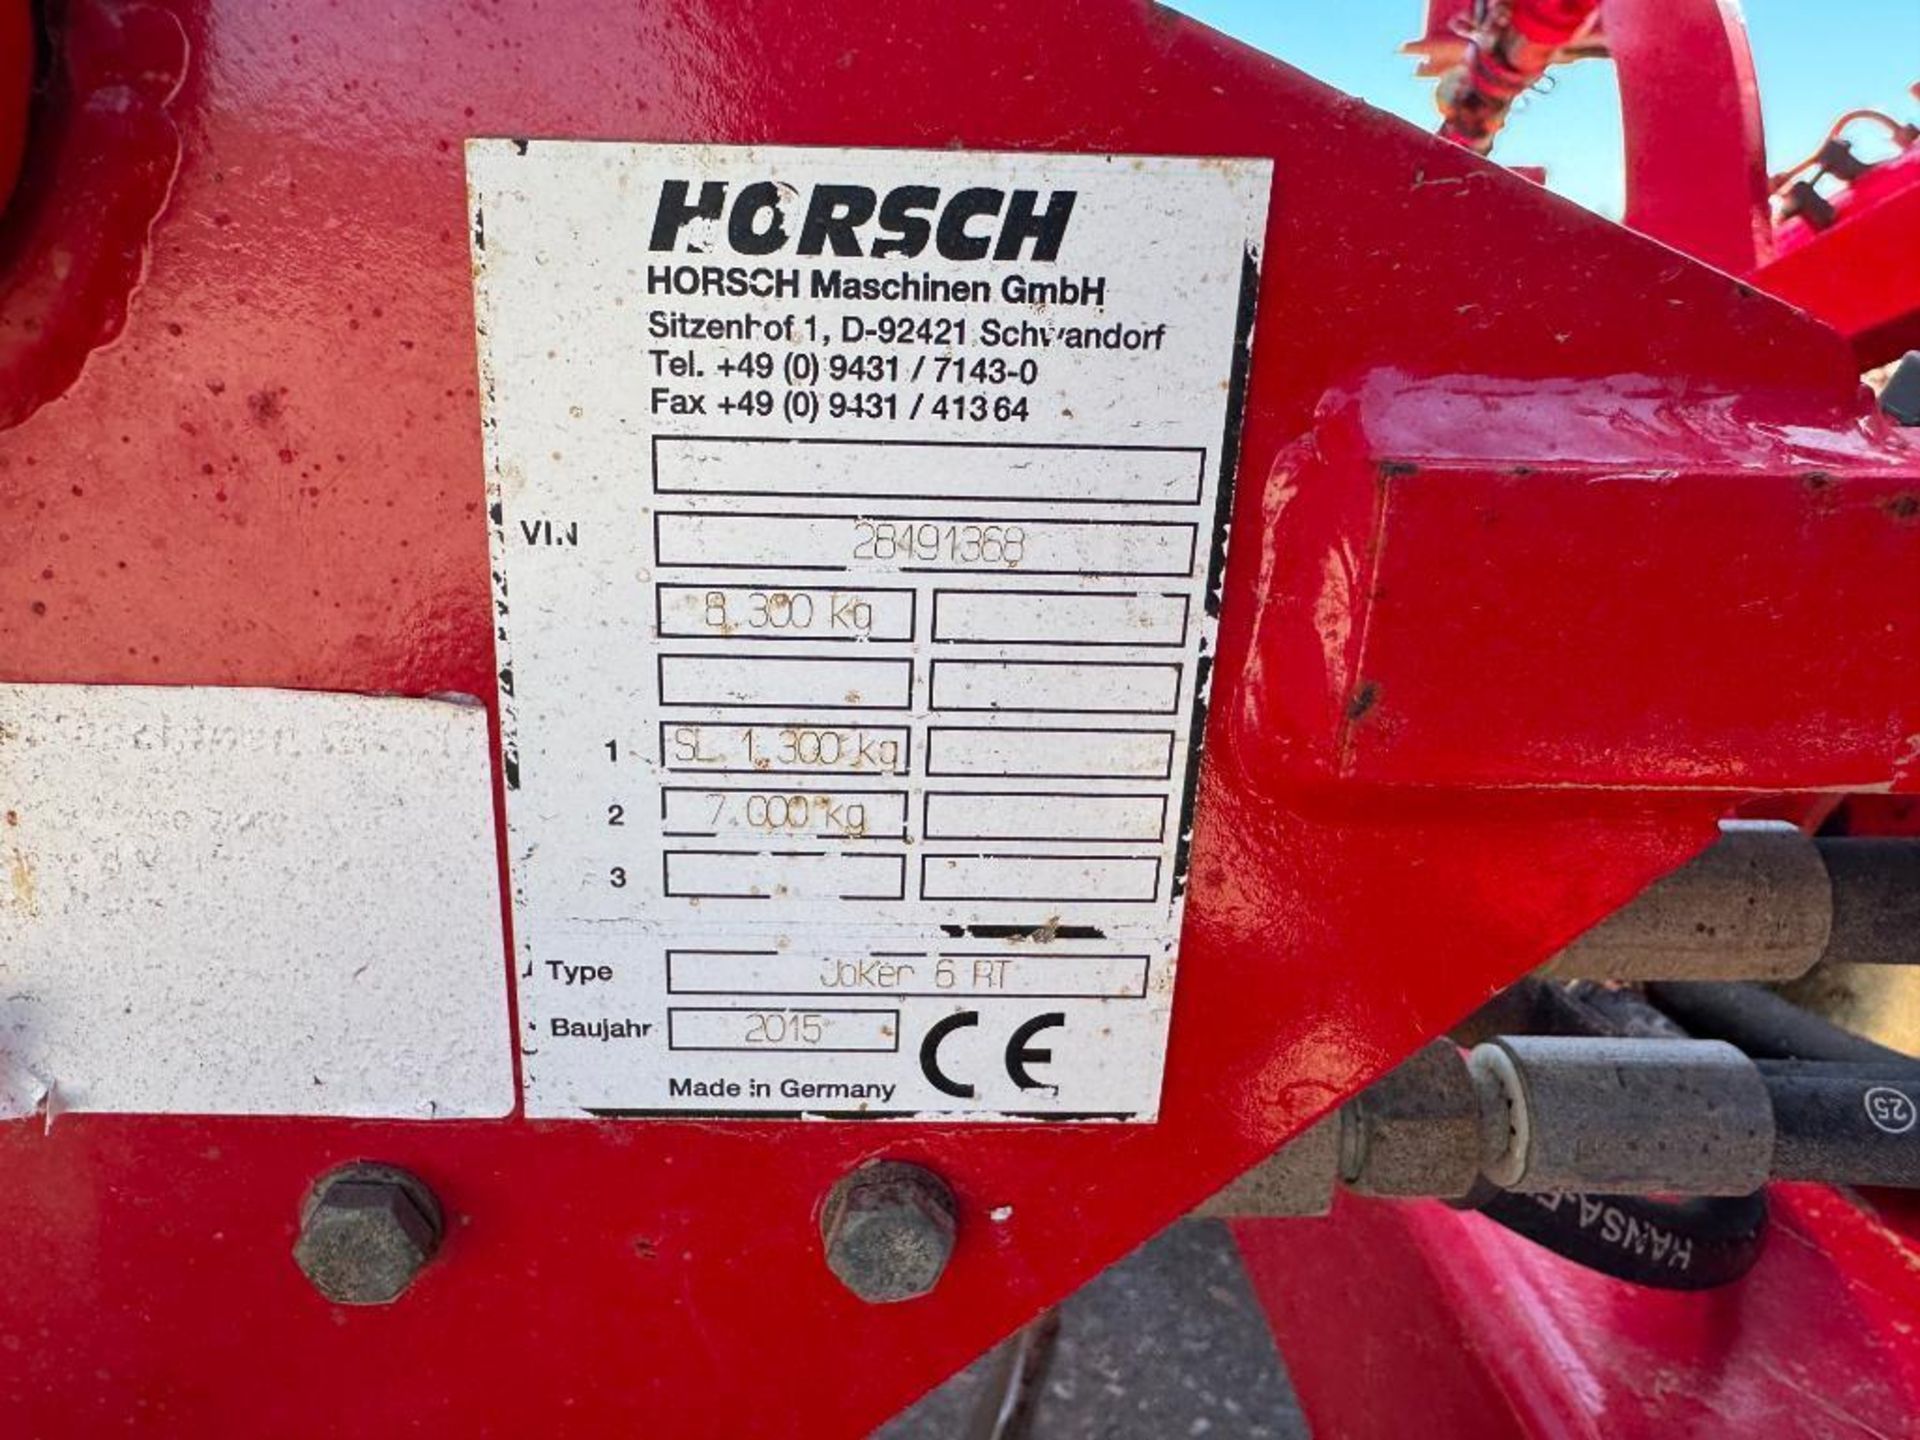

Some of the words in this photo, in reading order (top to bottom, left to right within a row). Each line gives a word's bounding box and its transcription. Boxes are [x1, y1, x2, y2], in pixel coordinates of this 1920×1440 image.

[648, 180, 1077, 261] HORSCH
[647, 265, 799, 299] HORSCH
[811, 270, 990, 302] Maschinen
[1001, 275, 1104, 307] GmbH
[648, 311, 794, 341] Sitzenhof
[805, 315, 830, 347] 1,
[842, 317, 966, 346] D-92421
[980, 318, 1166, 350] Schwandorf
[649, 350, 704, 378] Tel.
[717, 352, 774, 379] +49
[784, 352, 819, 386] (0)
[829, 354, 899, 382] 9431
[910, 356, 926, 383] /
[934, 357, 1038, 385] 7143-0
[651, 387, 706, 415] Fax
[717, 390, 774, 416] +49
[784, 390, 819, 423] (0)
[829, 392, 897, 419] 9431
[909, 393, 924, 420] /
[520, 519, 578, 546] VIN
[853, 521, 1025, 563] 28491368
[605, 740, 618, 762] 1
[608, 805, 624, 827] 2
[611, 867, 627, 889] 3
[546, 960, 614, 985] Type
[935, 958, 956, 989] 6
[972, 959, 1014, 990] RT
[550, 1017, 652, 1042] Baujahr
[744, 1012, 822, 1044] 2015
[669, 1077, 741, 1098] Made
[749, 1078, 771, 1098] in
[780, 1078, 896, 1103] Germany
[1872, 1096, 1909, 1122] 25
[1528, 1190, 1693, 1271] HANSA-F
